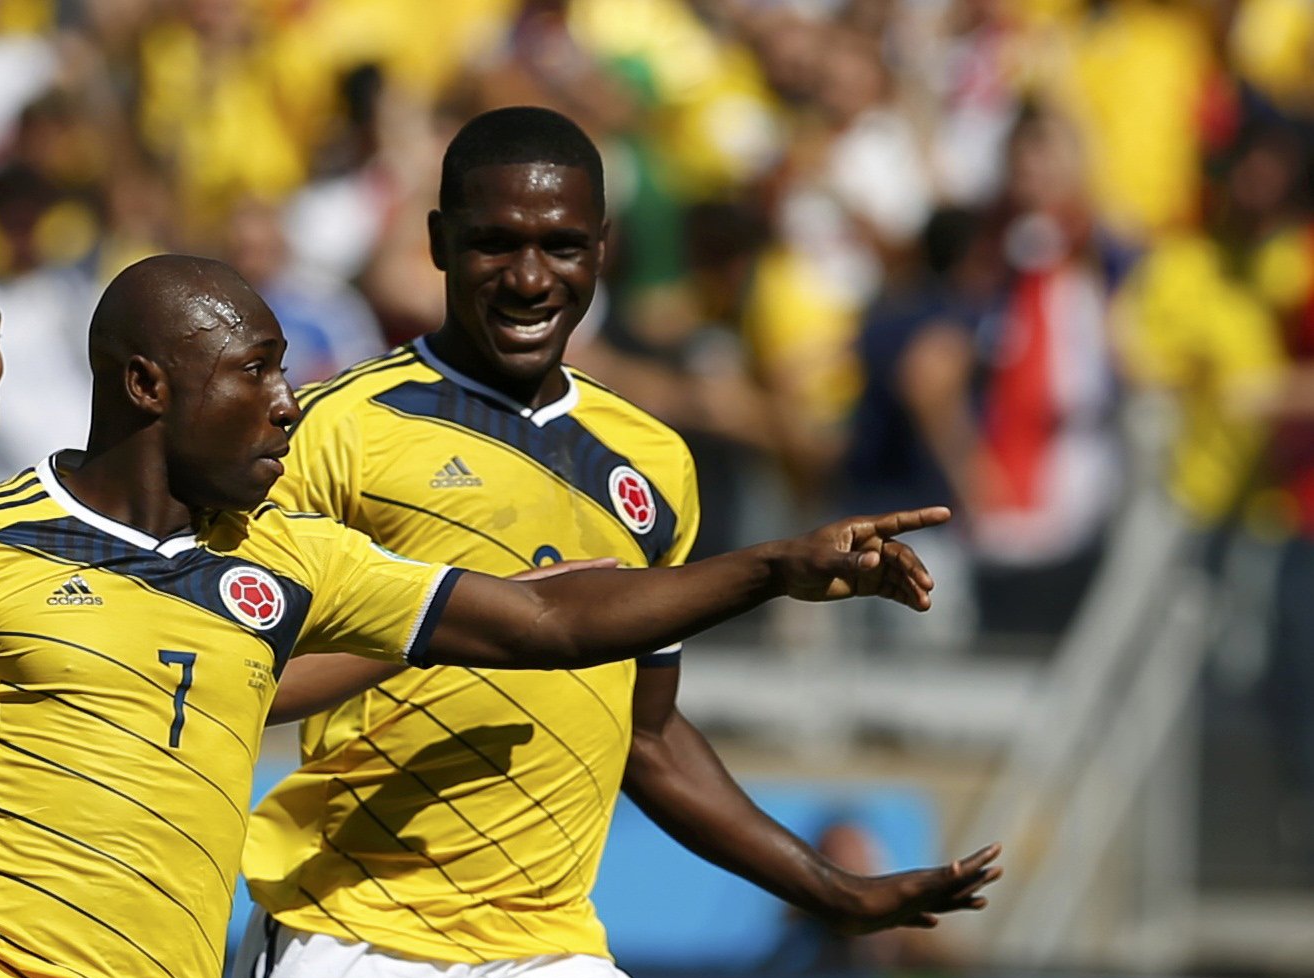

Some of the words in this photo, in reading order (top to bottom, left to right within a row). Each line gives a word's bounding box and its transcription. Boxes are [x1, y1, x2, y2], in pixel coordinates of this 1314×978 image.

[429, 476, 483, 488] adidas
[46, 593, 103, 606] adidas
[158, 649, 197, 748] 7
